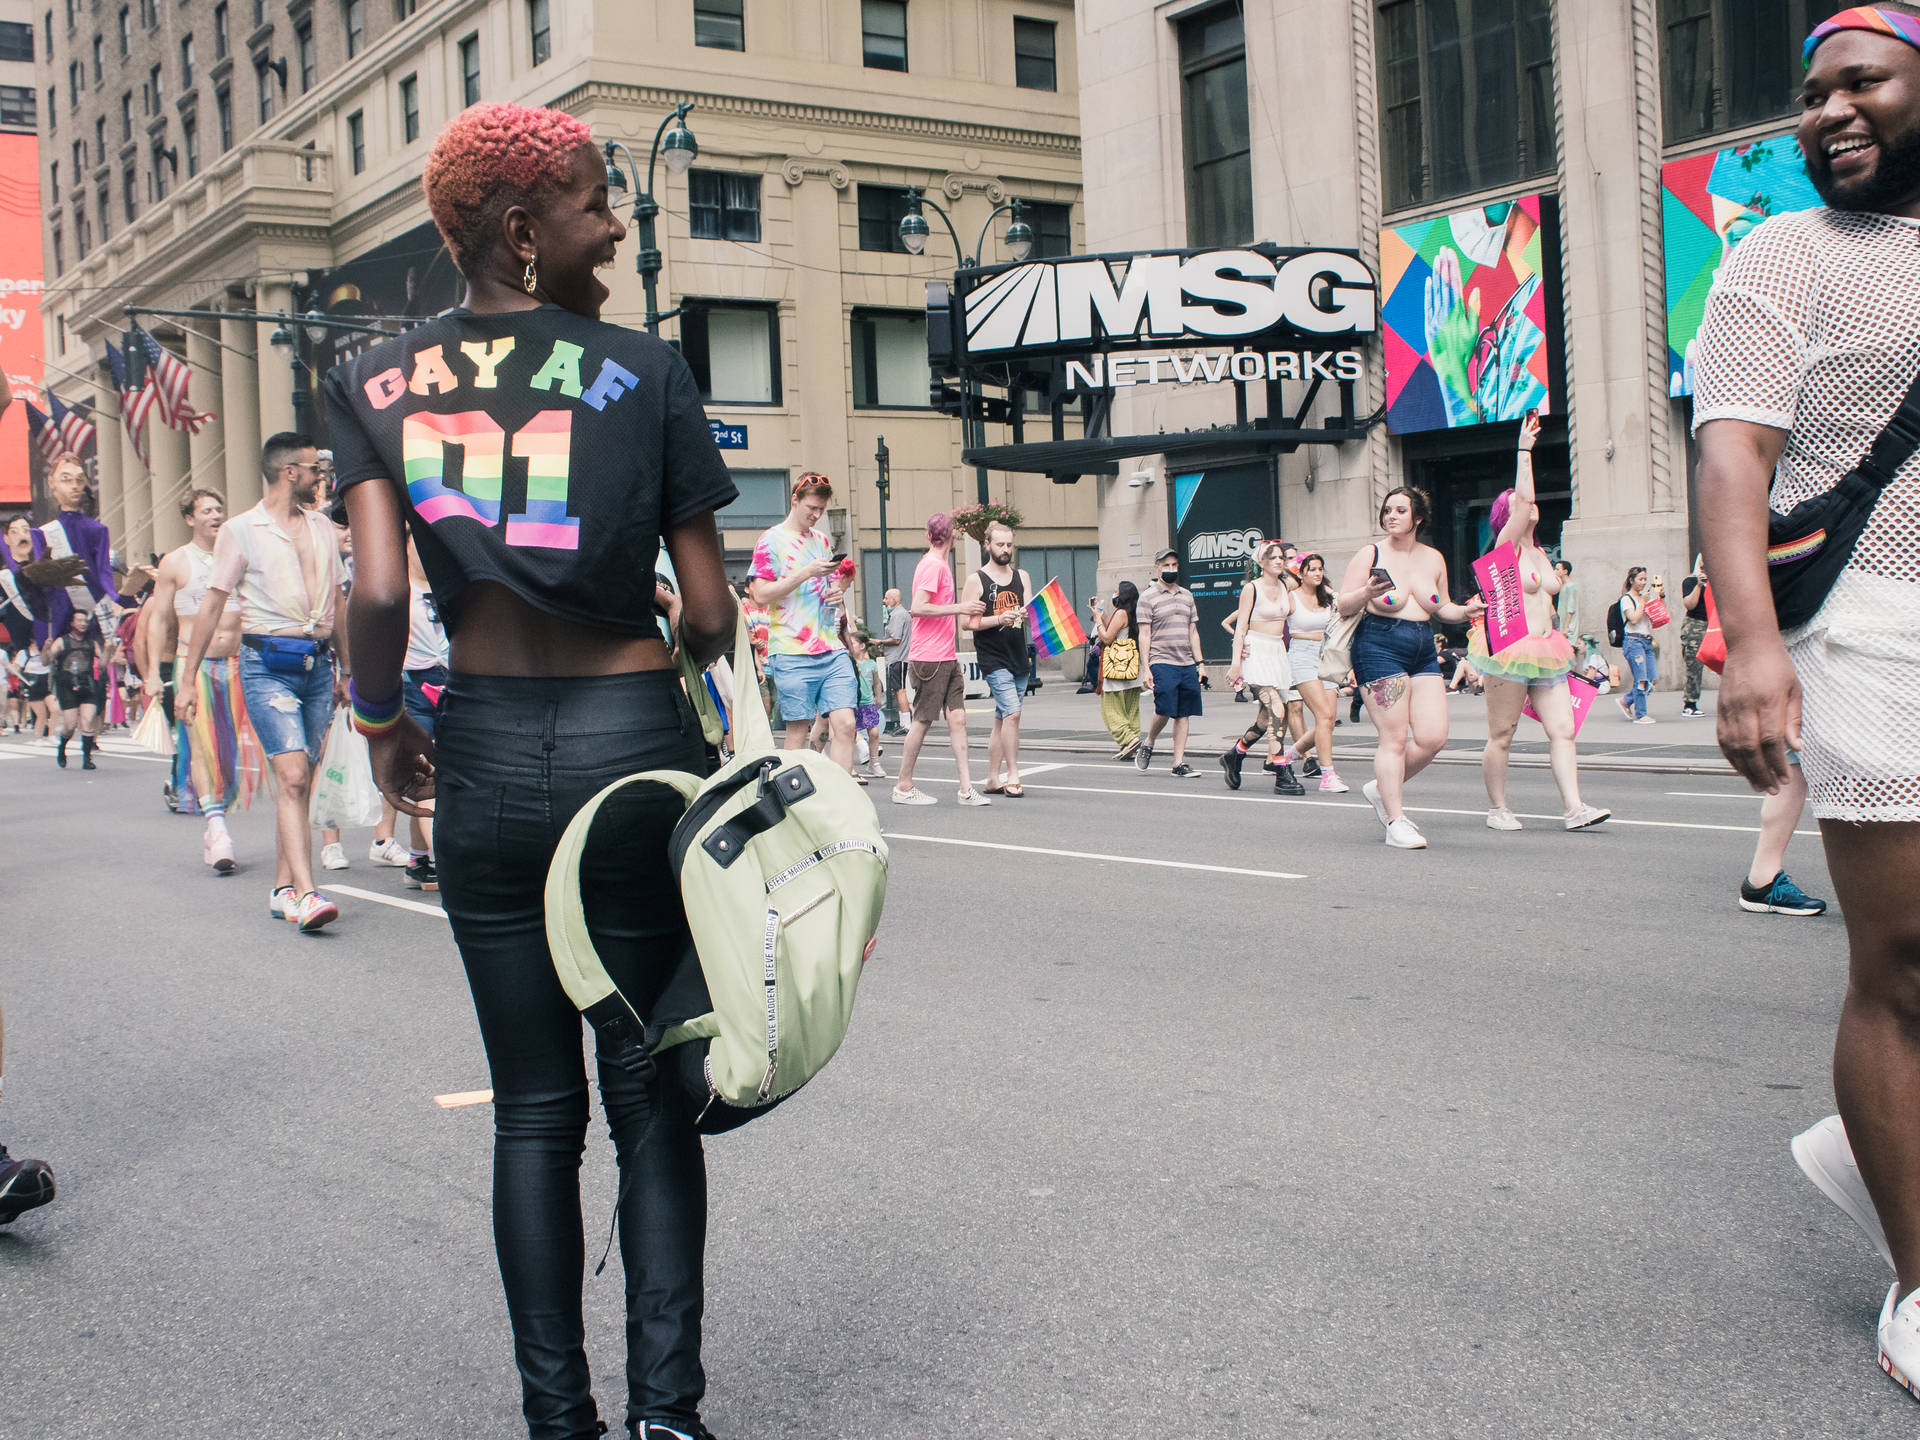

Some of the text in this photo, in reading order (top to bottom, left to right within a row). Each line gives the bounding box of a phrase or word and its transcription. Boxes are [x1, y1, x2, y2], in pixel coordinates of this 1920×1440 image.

[1056, 251, 1376, 340] MSG
[363, 336, 515, 410] GAY
[529, 339, 640, 412] AF
[1066, 351, 1363, 391] NETWORKS
[713, 430, 743, 444] 2nd St
[402, 410, 580, 550] 01
[1206, 529, 1263, 559] MSG
[1487, 562, 1509, 638] TRANS PEOPLE
[768, 872, 789, 890] STEVE
[788, 855, 817, 878] MADDEN
[820, 844, 838, 858] STEVE
[764, 915, 777, 1050] STEVE MADDEN STEVE MADDEN
